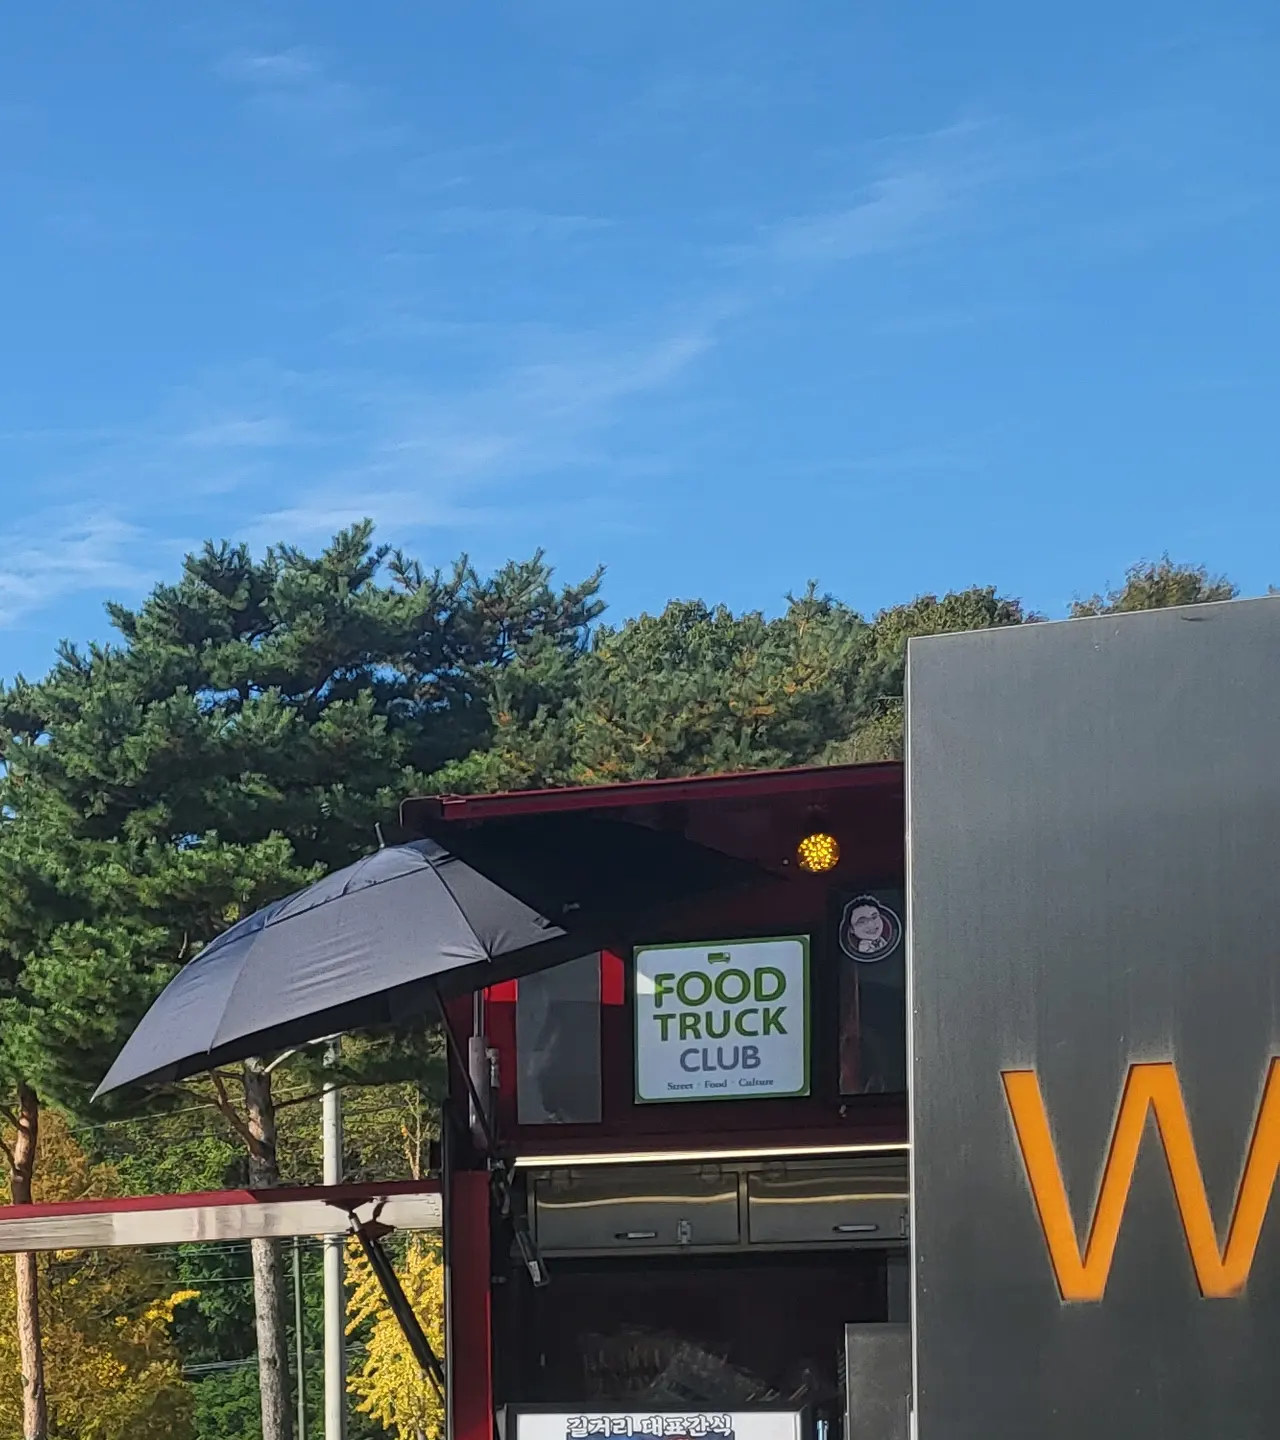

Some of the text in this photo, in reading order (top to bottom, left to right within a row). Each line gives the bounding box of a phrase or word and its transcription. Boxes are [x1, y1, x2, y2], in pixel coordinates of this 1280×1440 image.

[653, 966, 787, 1008] FOOD
[653, 1005, 788, 1041] TRUCK
[680, 1045, 761, 1073] CLUB
[667, 1077, 774, 1090] Street Food Culture
[567, 1414, 733, 1438] 길거리 대표간식
